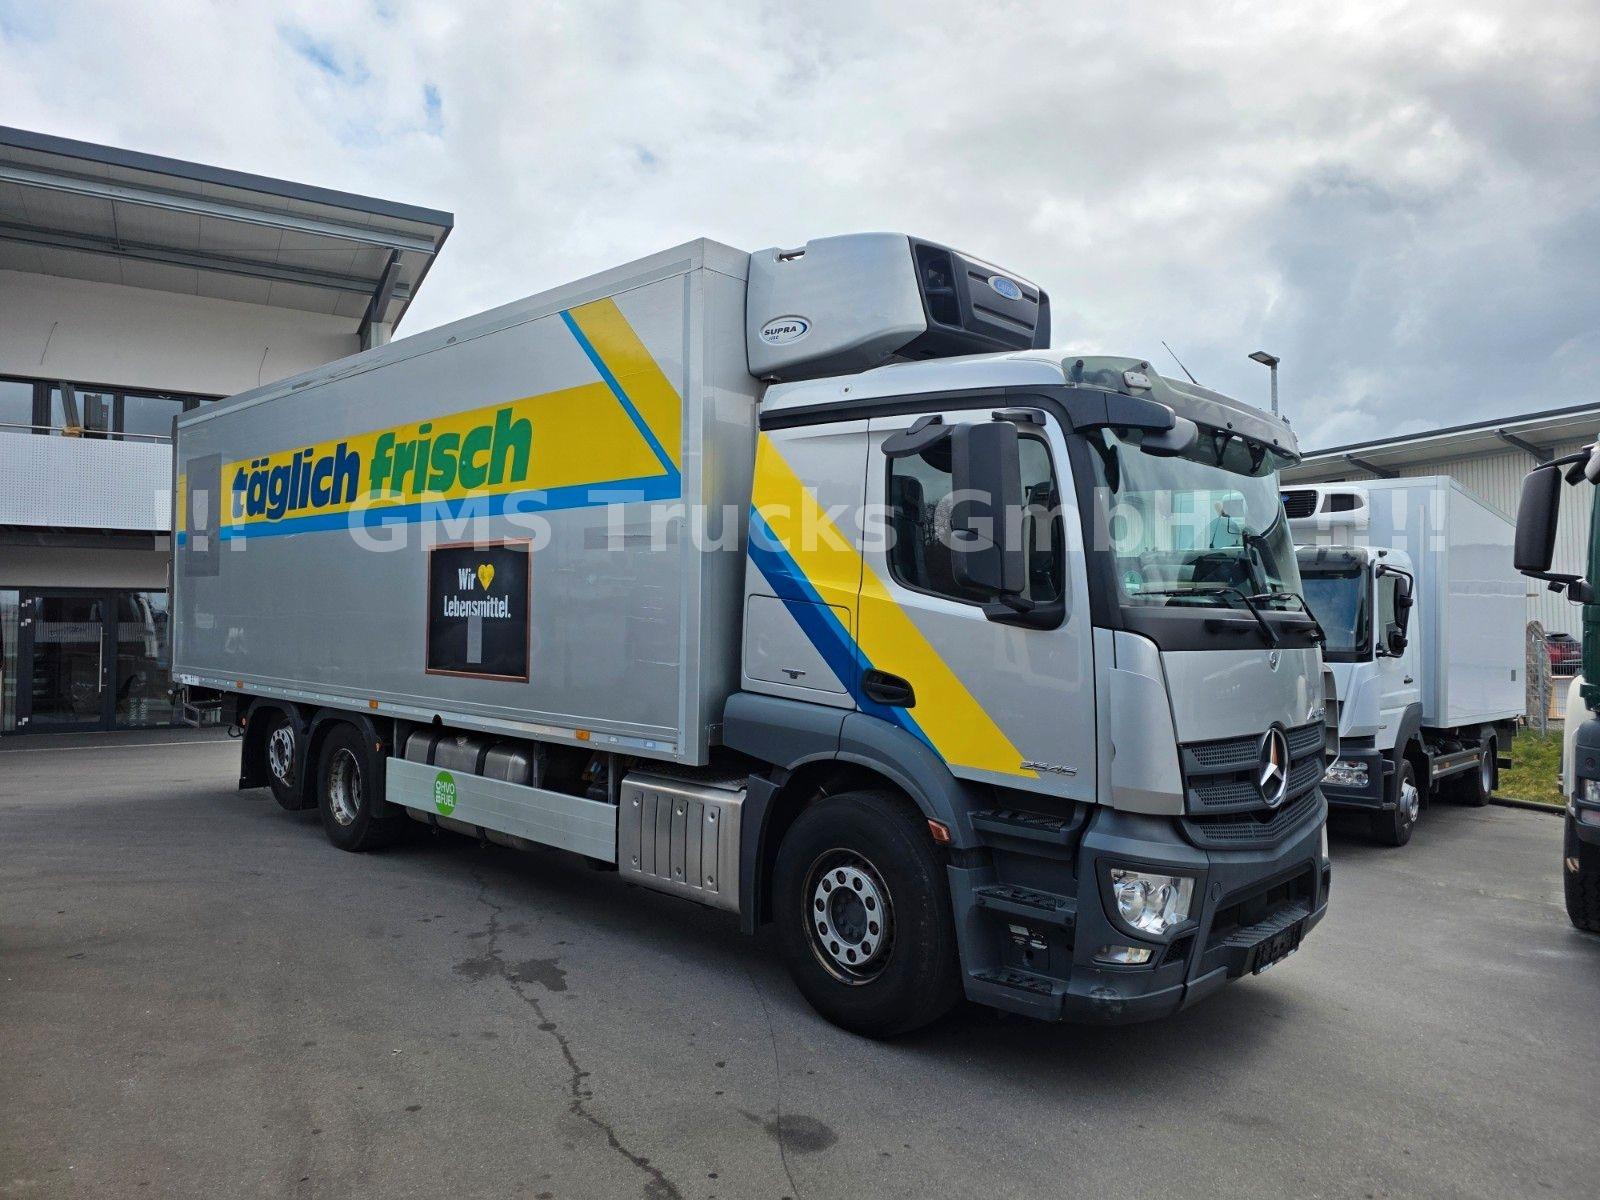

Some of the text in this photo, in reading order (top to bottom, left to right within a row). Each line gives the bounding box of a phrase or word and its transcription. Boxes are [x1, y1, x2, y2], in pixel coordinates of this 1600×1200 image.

[764, 326, 797, 336] SUPRA
[232, 407, 533, 520] täglich frisch
[458, 568, 476, 590] Wir
[443, 595, 512, 618] Lebensmittel.
